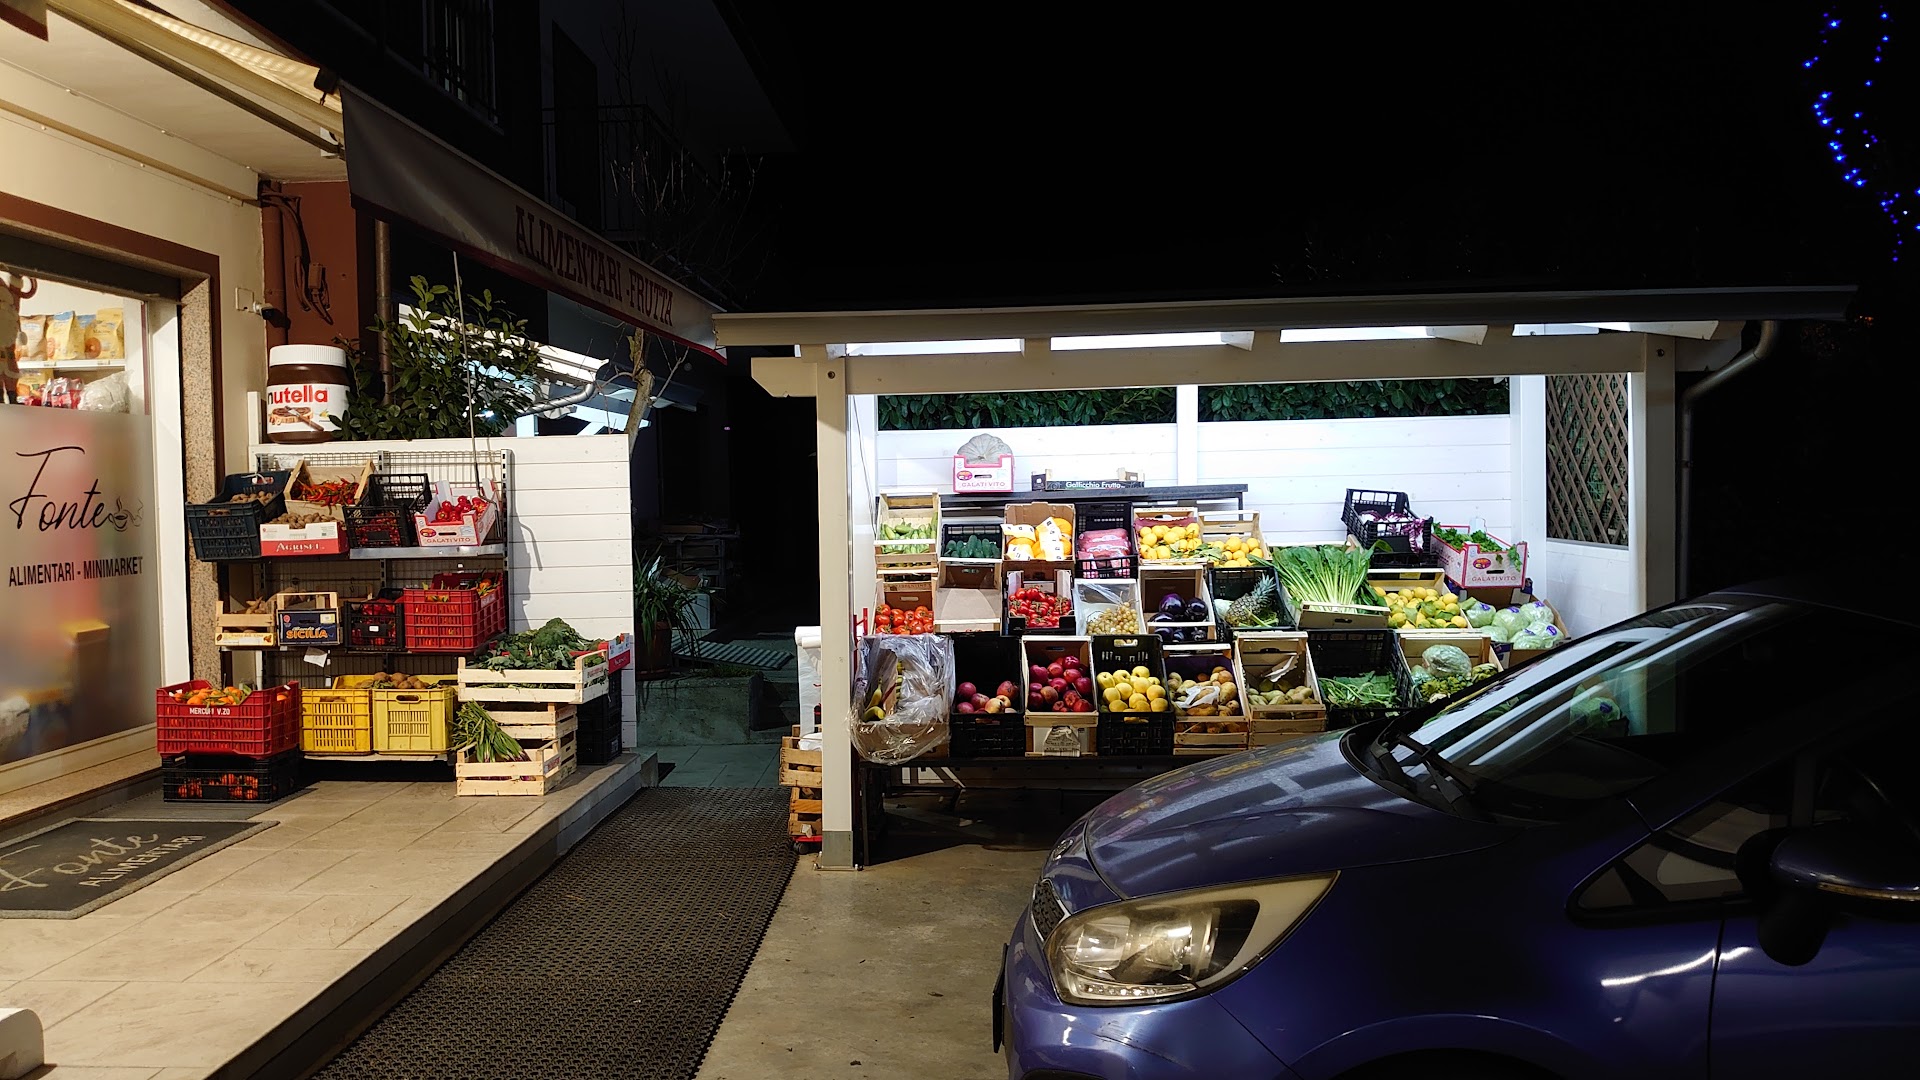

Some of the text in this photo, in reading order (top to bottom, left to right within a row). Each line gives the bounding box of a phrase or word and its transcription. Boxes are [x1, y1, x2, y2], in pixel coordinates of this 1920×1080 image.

[516, 205, 622, 302] ALIMENTARI
[267, 385, 329, 405] nutella
[9, 446, 111, 531] Fonte
[9, 562, 75, 587] ALIMENTARI
[83, 556, 143, 579] MINIMARKET
[286, 629, 328, 639] SICILIA
[0, 834, 159, 891] Fonte
[78, 835, 207, 887] ALIMENTARI
